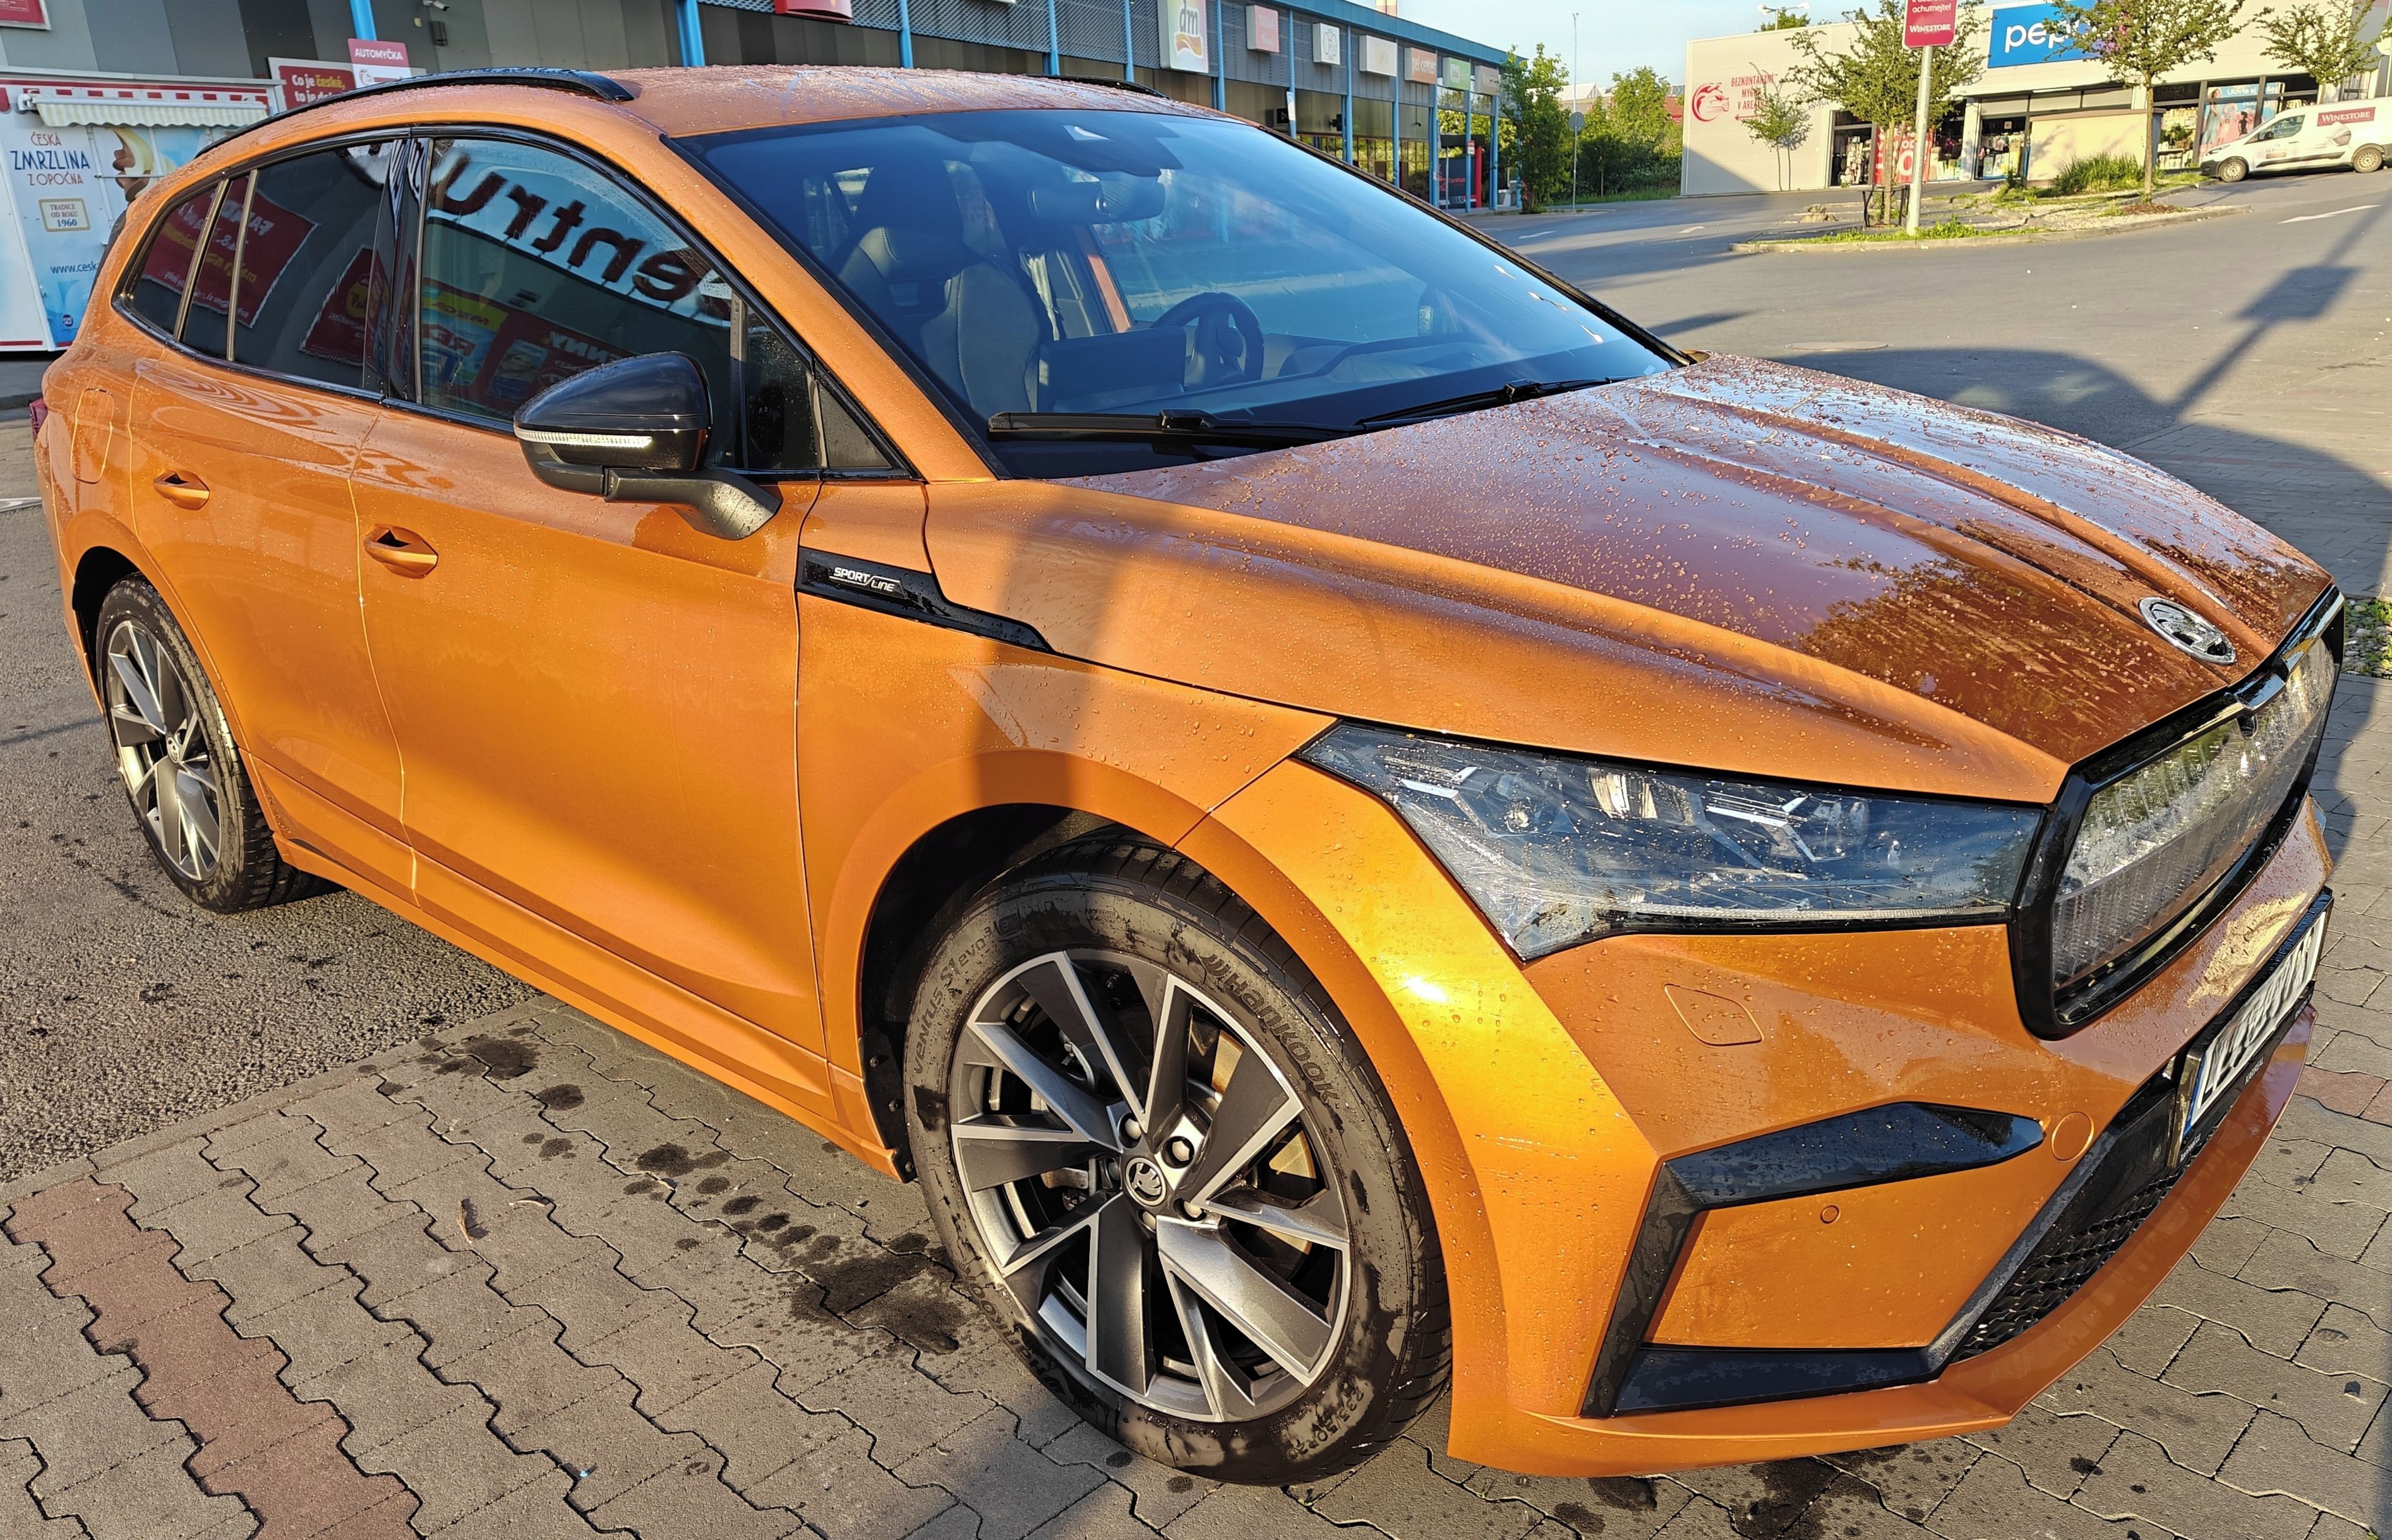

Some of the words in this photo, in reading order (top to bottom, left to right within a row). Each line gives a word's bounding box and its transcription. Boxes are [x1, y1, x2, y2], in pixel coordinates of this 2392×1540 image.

[1912, 3, 1951, 13] ochutnejte!
[1179, 0, 1198, 35] dm
[1909, 24, 1951, 33] WINESTORE
[2004, 19, 2097, 54] pep
[354, 48, 404, 61] AUTOMYČKA
[291, 74, 304, 87] Co
[304, 73, 315, 88] je
[294, 90, 306, 102] to
[2321, 111, 2371, 123] WINESTORE
[30, 131, 62, 147] ČESKÁ
[9, 150, 91, 171] ZMRZLINA
[37, 171, 83, 186] OPOČNA
[57, 219, 77, 227] 1960
[50, 261, 99, 274] www.cesk
